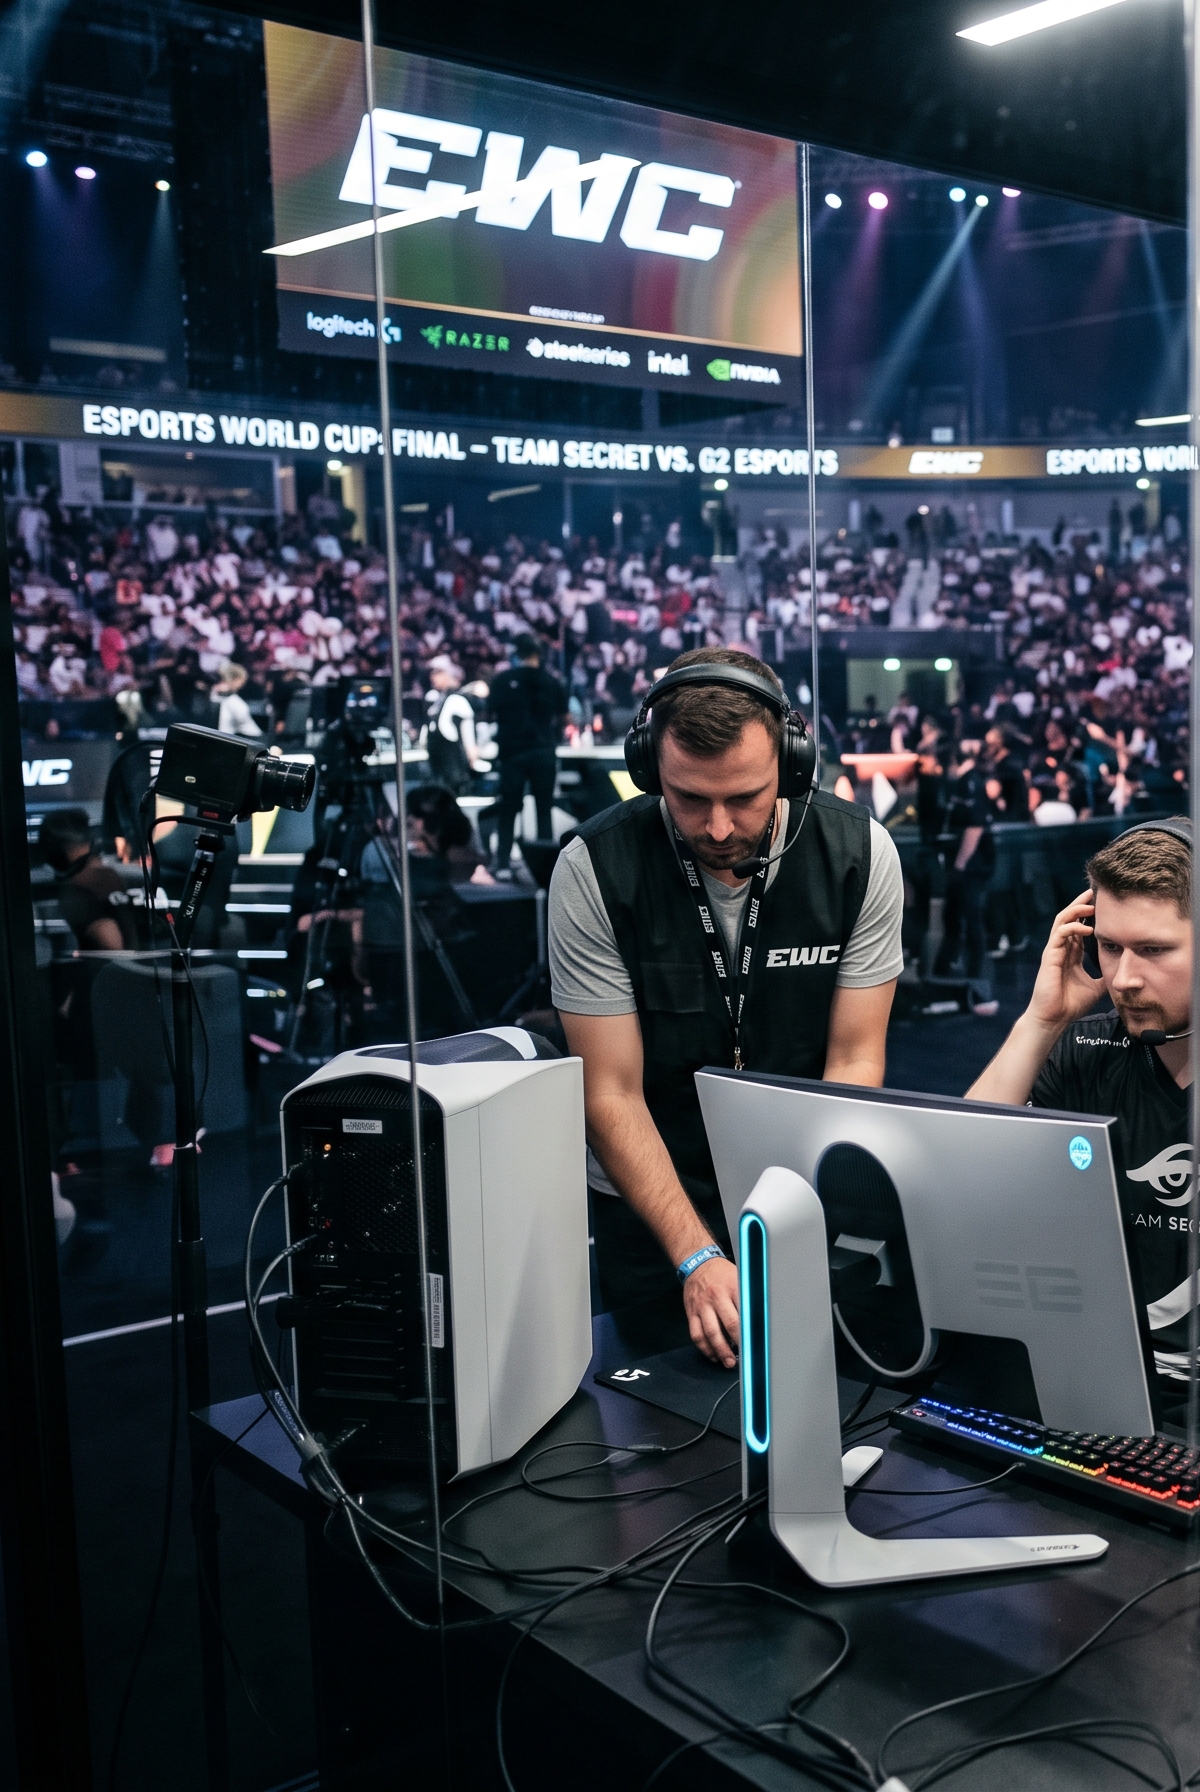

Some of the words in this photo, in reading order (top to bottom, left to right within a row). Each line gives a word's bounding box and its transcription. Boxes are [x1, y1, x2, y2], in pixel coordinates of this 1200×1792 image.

[338, 108, 736, 262] EWC
[306, 311, 375, 338] logitech
[445, 329, 510, 352] RAZER
[82, 404, 216, 443] ESPORTS
[219, 415, 320, 450] WORLD
[392, 428, 467, 461] FINAL
[491, 436, 560, 467] TEAM
[563, 440, 654, 472] SECRET
[654, 445, 695, 473] VS.
[698, 446, 731, 474] G2
[734, 447, 839, 476] ESPORTS
[908, 451, 984, 475] EWC
[1046, 446, 1141, 476] ESPORTS
[766, 945, 841, 968] EWC
[1134, 1213, 1162, 1228] AM
